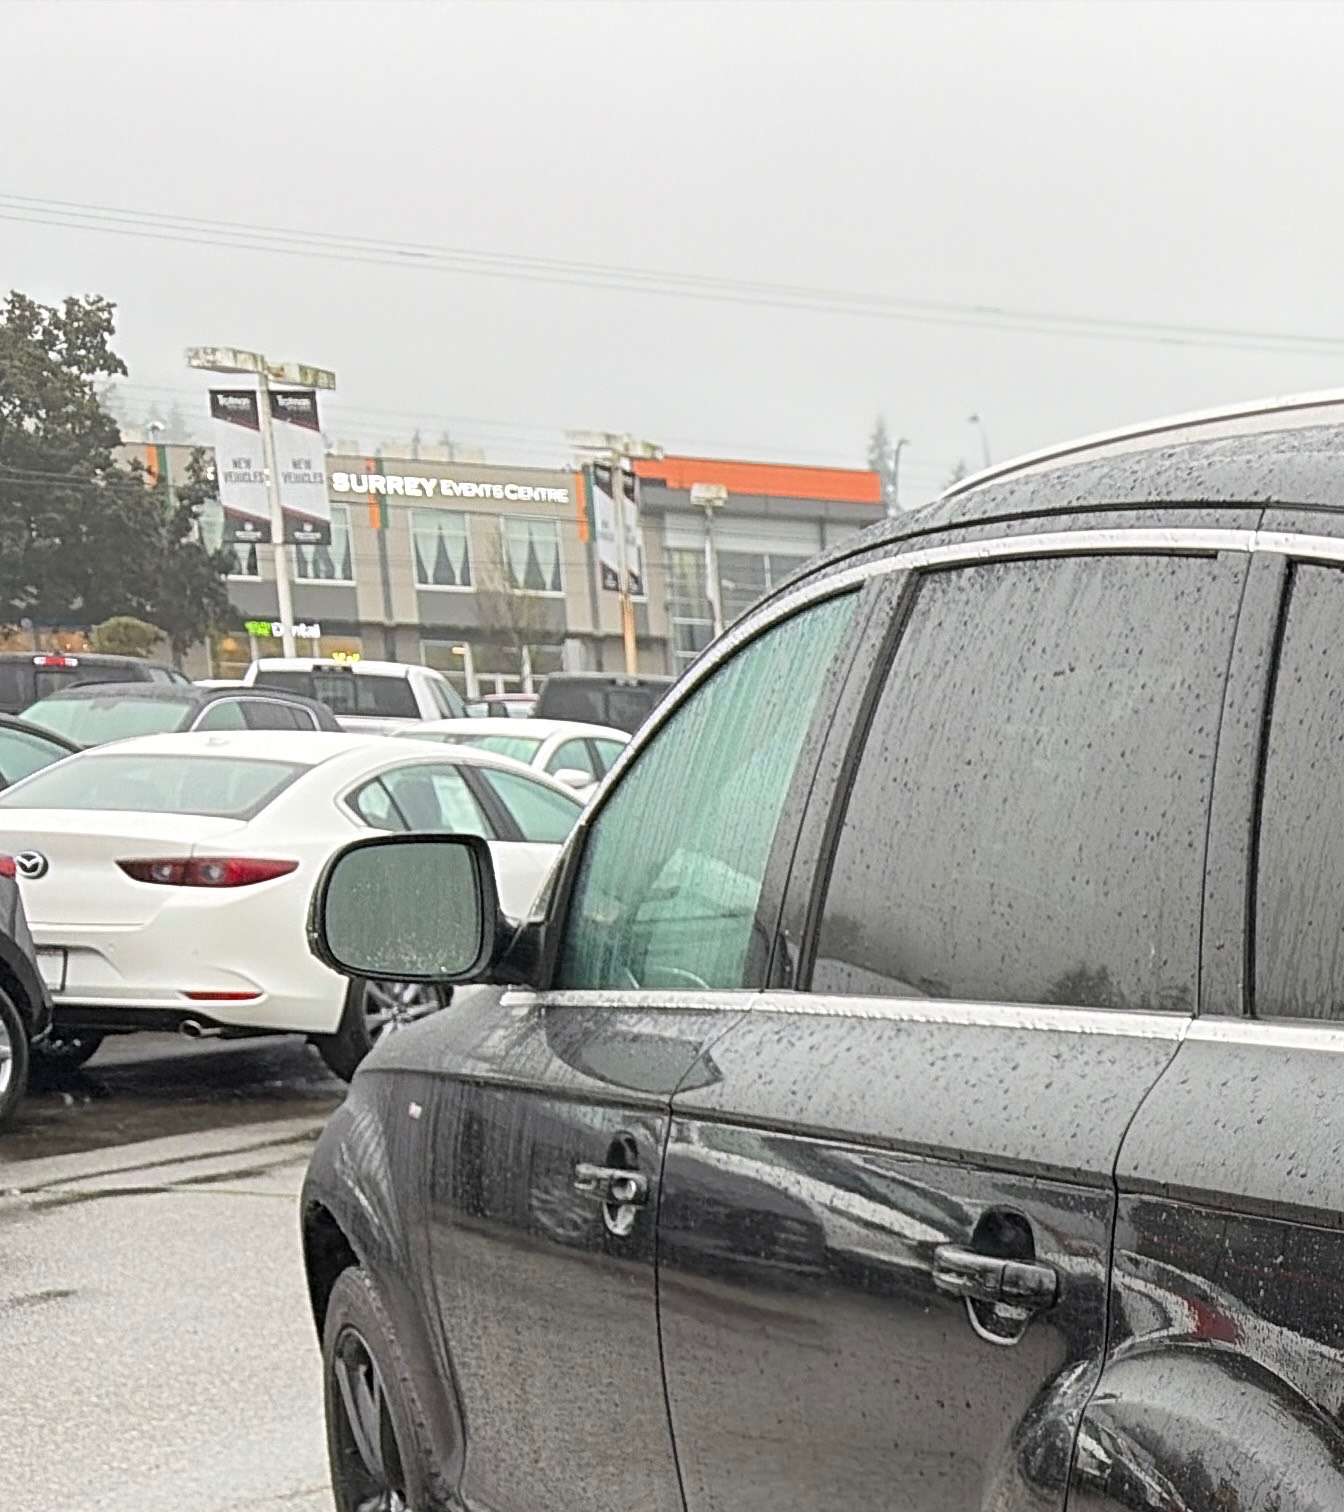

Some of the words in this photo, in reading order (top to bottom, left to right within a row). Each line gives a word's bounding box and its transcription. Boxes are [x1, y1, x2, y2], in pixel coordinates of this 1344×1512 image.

[232, 457, 251, 469] NEW
[291, 458, 312, 470] NEW
[332, 472, 437, 498] SURREY
[440, 479, 504, 500] EVENTS
[503, 483, 569, 504] CENTRE
[271, 621, 321, 639] Dntal
